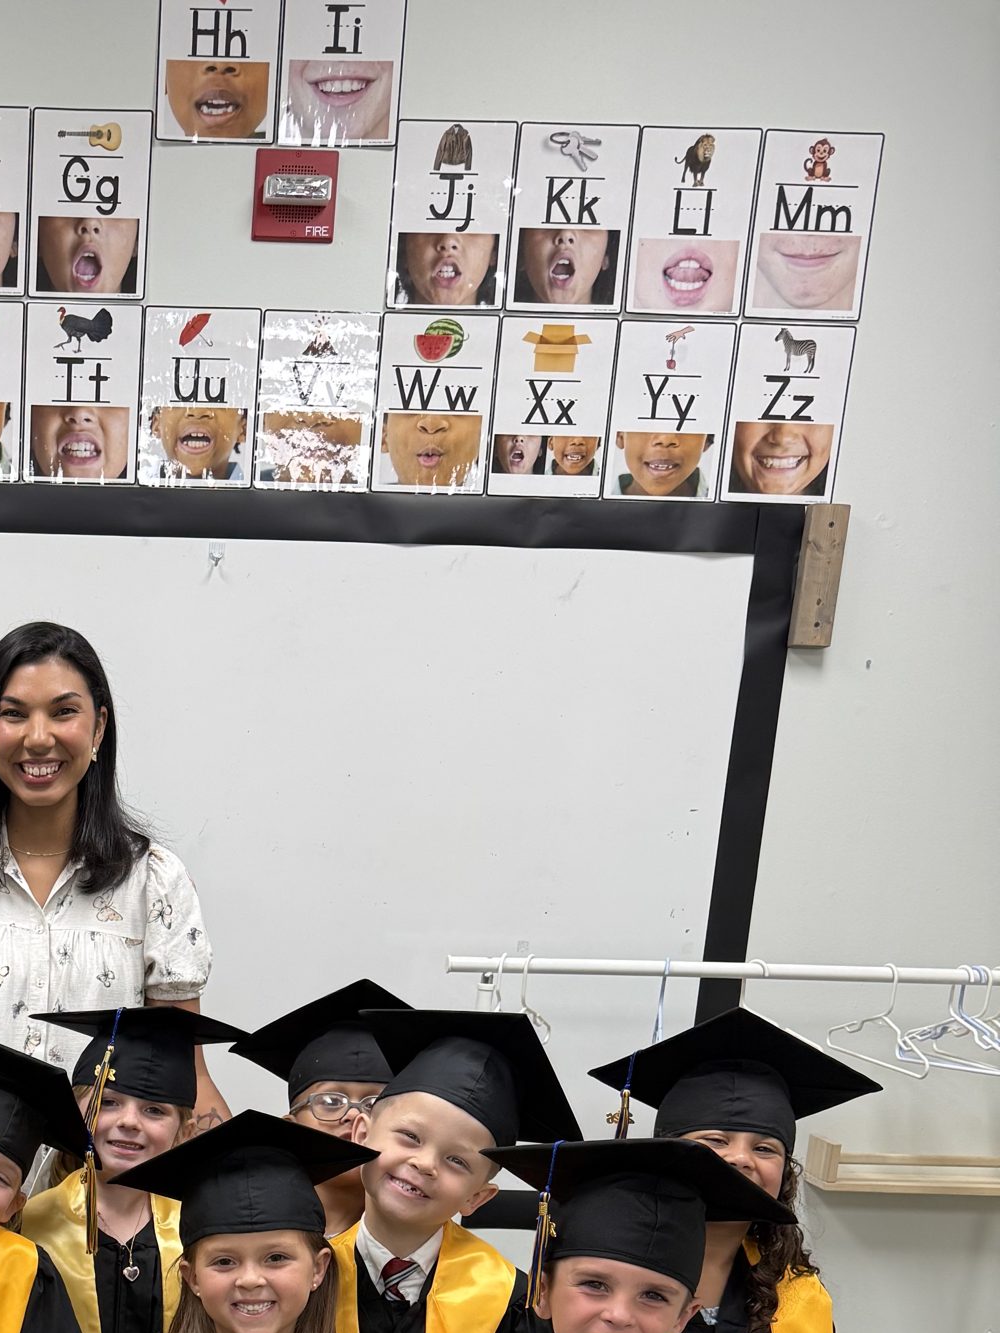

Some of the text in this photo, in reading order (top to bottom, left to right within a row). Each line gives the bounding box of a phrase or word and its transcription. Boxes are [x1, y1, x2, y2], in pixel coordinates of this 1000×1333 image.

[191, 9, 247, 58] Hh
[324, 5, 362, 54] Ii
[62, 157, 121, 215] Gg
[430, 174, 474, 232] Jj
[545, 178, 599, 225] Kk
[305, 226, 329, 237] FIRE
[673, 189, 712, 235] Ll
[776, 187, 852, 232] Mm
[56, 357, 108, 402] Tt
[173, 358, 225, 402] Uu
[292, 362, 345, 406] Vv
[395, 368, 477, 412] Ww
[760, 377, 814, 421] Zz
[524, 380, 576, 425] Xx
[644, 376, 696, 431] Yy
